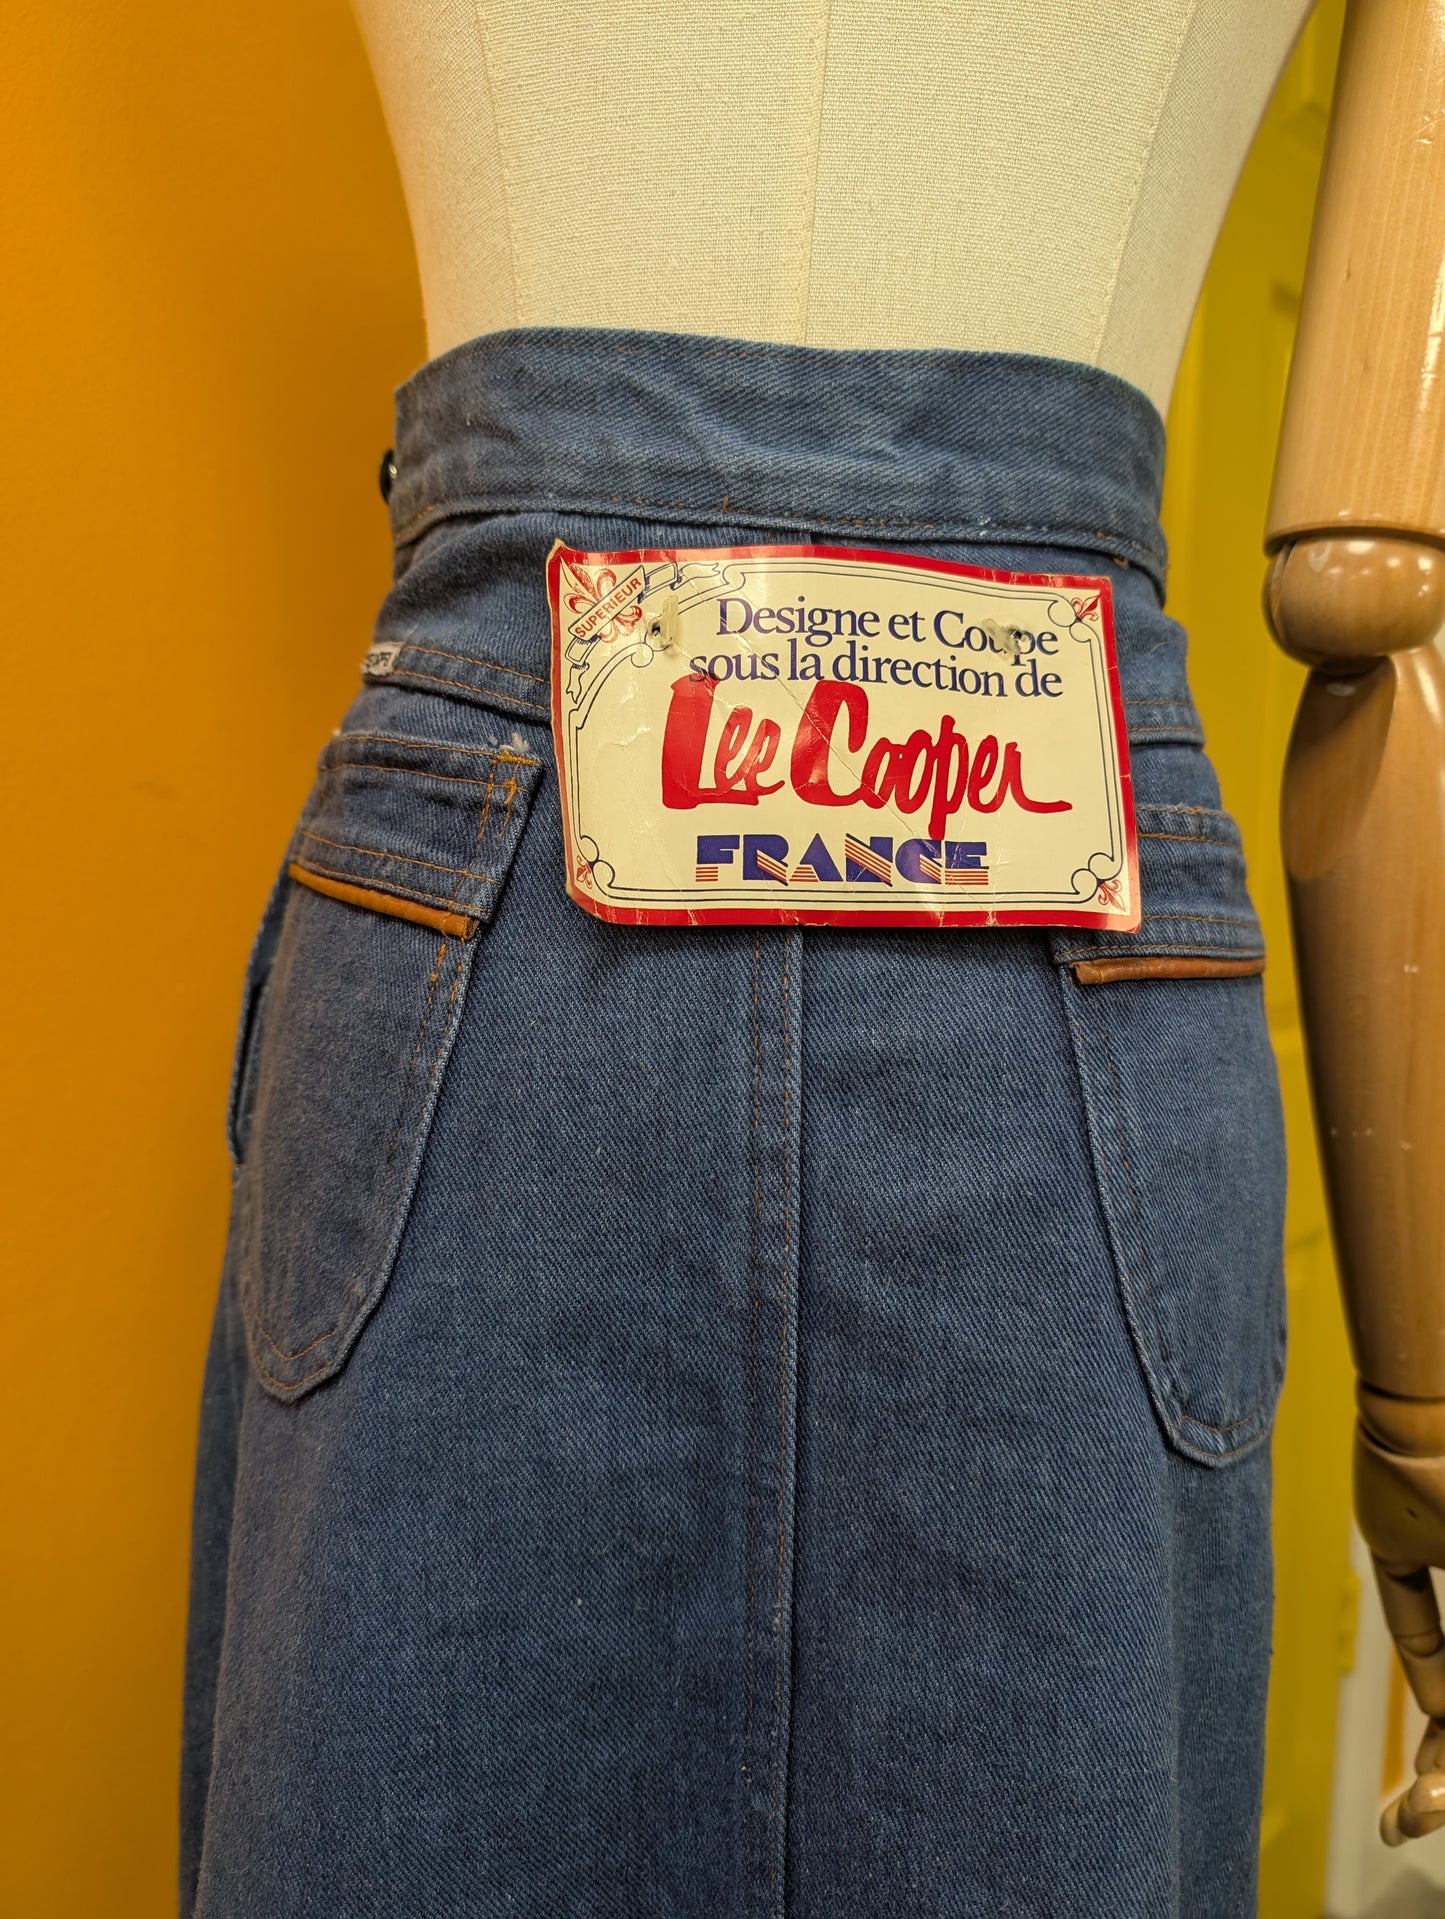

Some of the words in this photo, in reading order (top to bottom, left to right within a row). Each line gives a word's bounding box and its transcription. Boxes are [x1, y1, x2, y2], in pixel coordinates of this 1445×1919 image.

[574, 577, 642, 638] SUPERIEUR
[716, 595, 880, 647] Designe
[888, 611, 926, 642] et
[688, 653, 780, 683] sous
[787, 638, 825, 681] la
[832, 640, 1008, 697] direction
[1015, 658, 1063, 697] de
[661, 673, 785, 810] Lee
[791, 680, 1072, 840] Cooper
[695, 833, 990, 887] FRANCE
